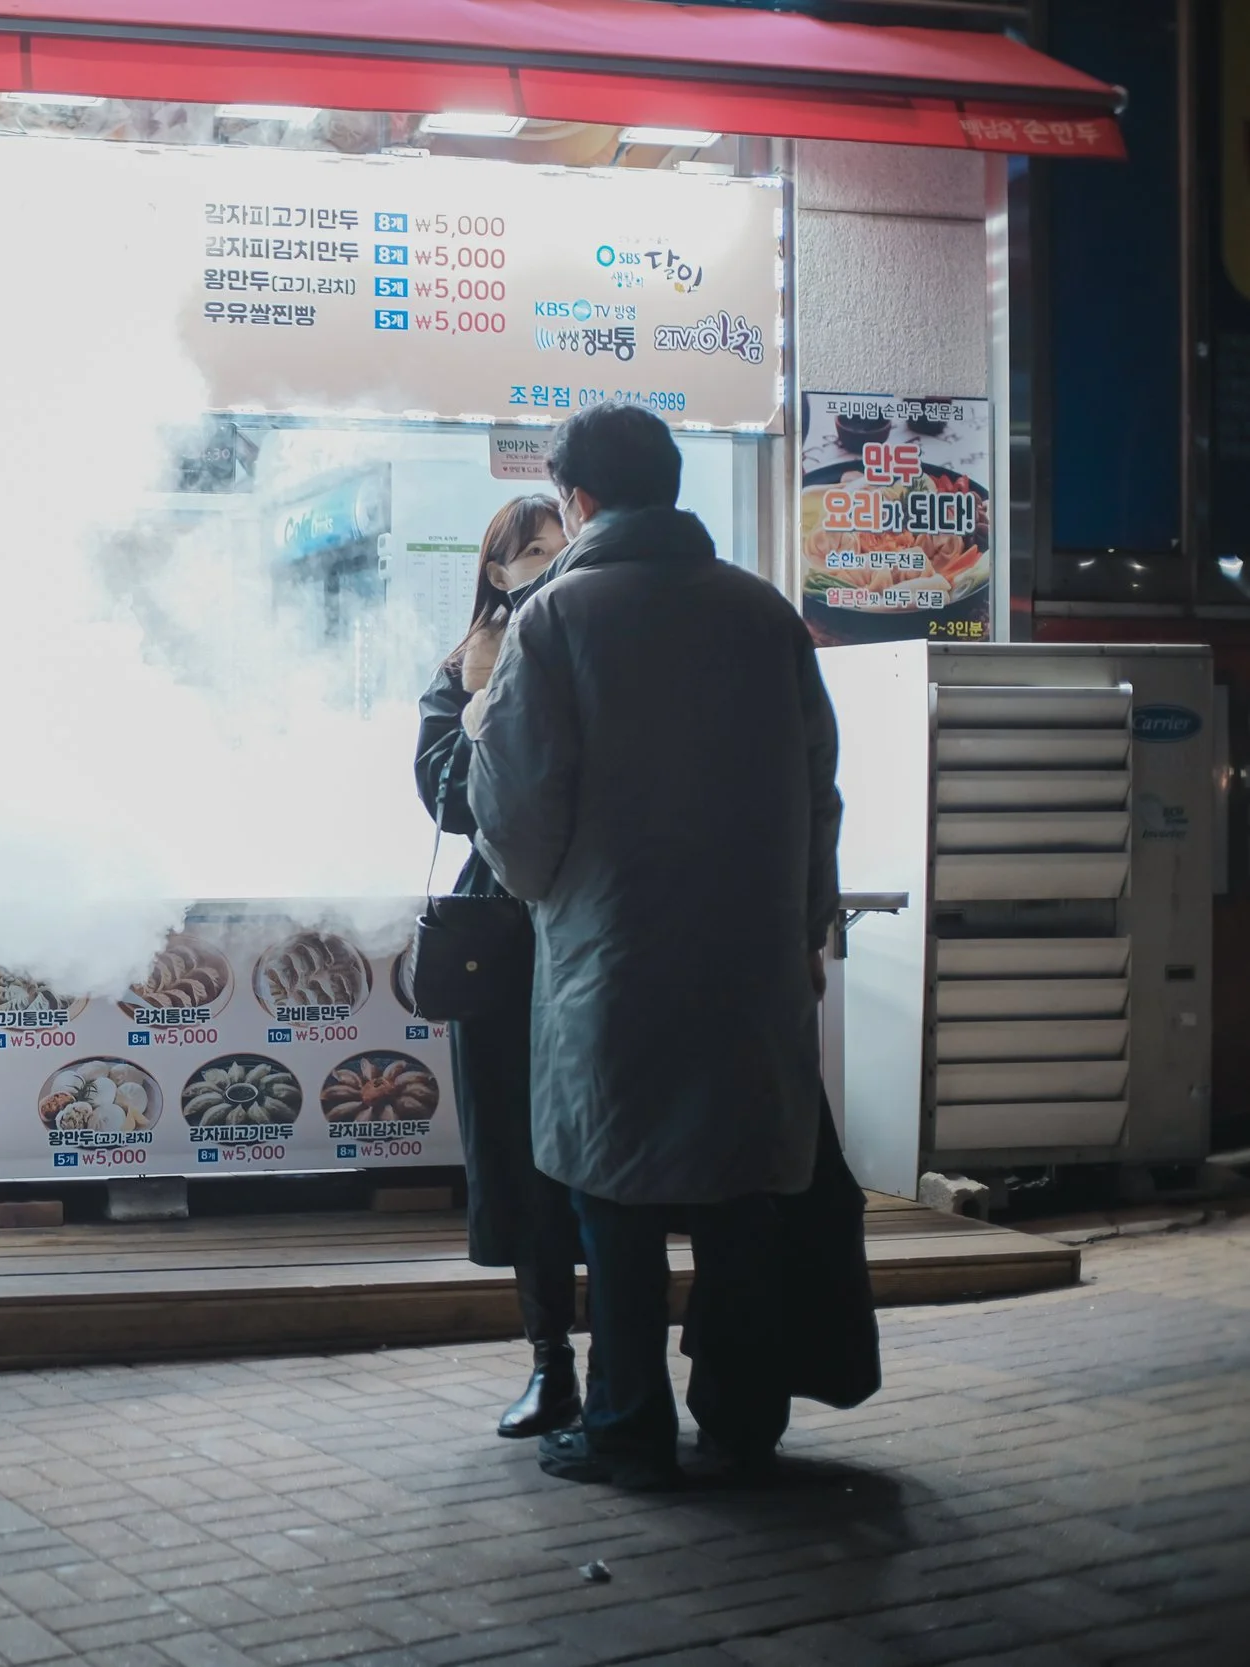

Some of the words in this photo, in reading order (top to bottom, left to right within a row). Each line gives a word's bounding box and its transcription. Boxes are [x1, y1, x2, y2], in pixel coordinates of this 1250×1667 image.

[205, 203, 359, 231] 감자피고기만두
[377, 213, 404, 232] 8개
[205, 236, 360, 263] 감자피김치만두
[377, 246, 404, 264] 8개
[618, 251, 642, 265] SBS
[203, 268, 356, 296] 왕만두(고기,김치)
[378, 278, 404, 297] 5개
[203, 301, 317, 327] 우유쌀찐빵
[378, 311, 404, 329] 5개
[535, 301, 570, 317] KBS
[594, 304, 611, 318] TV
[614, 304, 637, 321] 방영
[508, 385, 571, 407] 조원점
[825, 400, 878, 419] 프리미엄
[882, 402, 923, 420] 손만두
[926, 403, 965, 421] 전문점
[496, 439, 539, 453] 받아가는
[863, 443, 922, 485] 만두
[823, 490, 903, 532] 요리가
[908, 492, 974, 533] 되다!
[826, 589, 879, 607] 얼큰한맛
[884, 590, 911, 607] 만두
[915, 590, 944, 609] 전골
[928, 620, 983, 637] 2~3인분
[1133, 714, 1192, 731] Carrier
[135, 1008, 211, 1025] 김치통만두
[276, 1005, 351, 1022] 갈비통만두
[131, 1034, 147, 1044] 8개
[269, 1031, 291, 1042] 10개
[408, 1027, 426, 1038] 5개
[189, 1124, 294, 1142] 감자피고기만두
[328, 1121, 431, 1138] 감자피김치만두
[48, 1131, 153, 1146] 왕만두(고기,김치)
[57, 1154, 75, 1166] 5개
[200, 1150, 216, 1161] 8개
[339, 1146, 355, 1157] 8개
